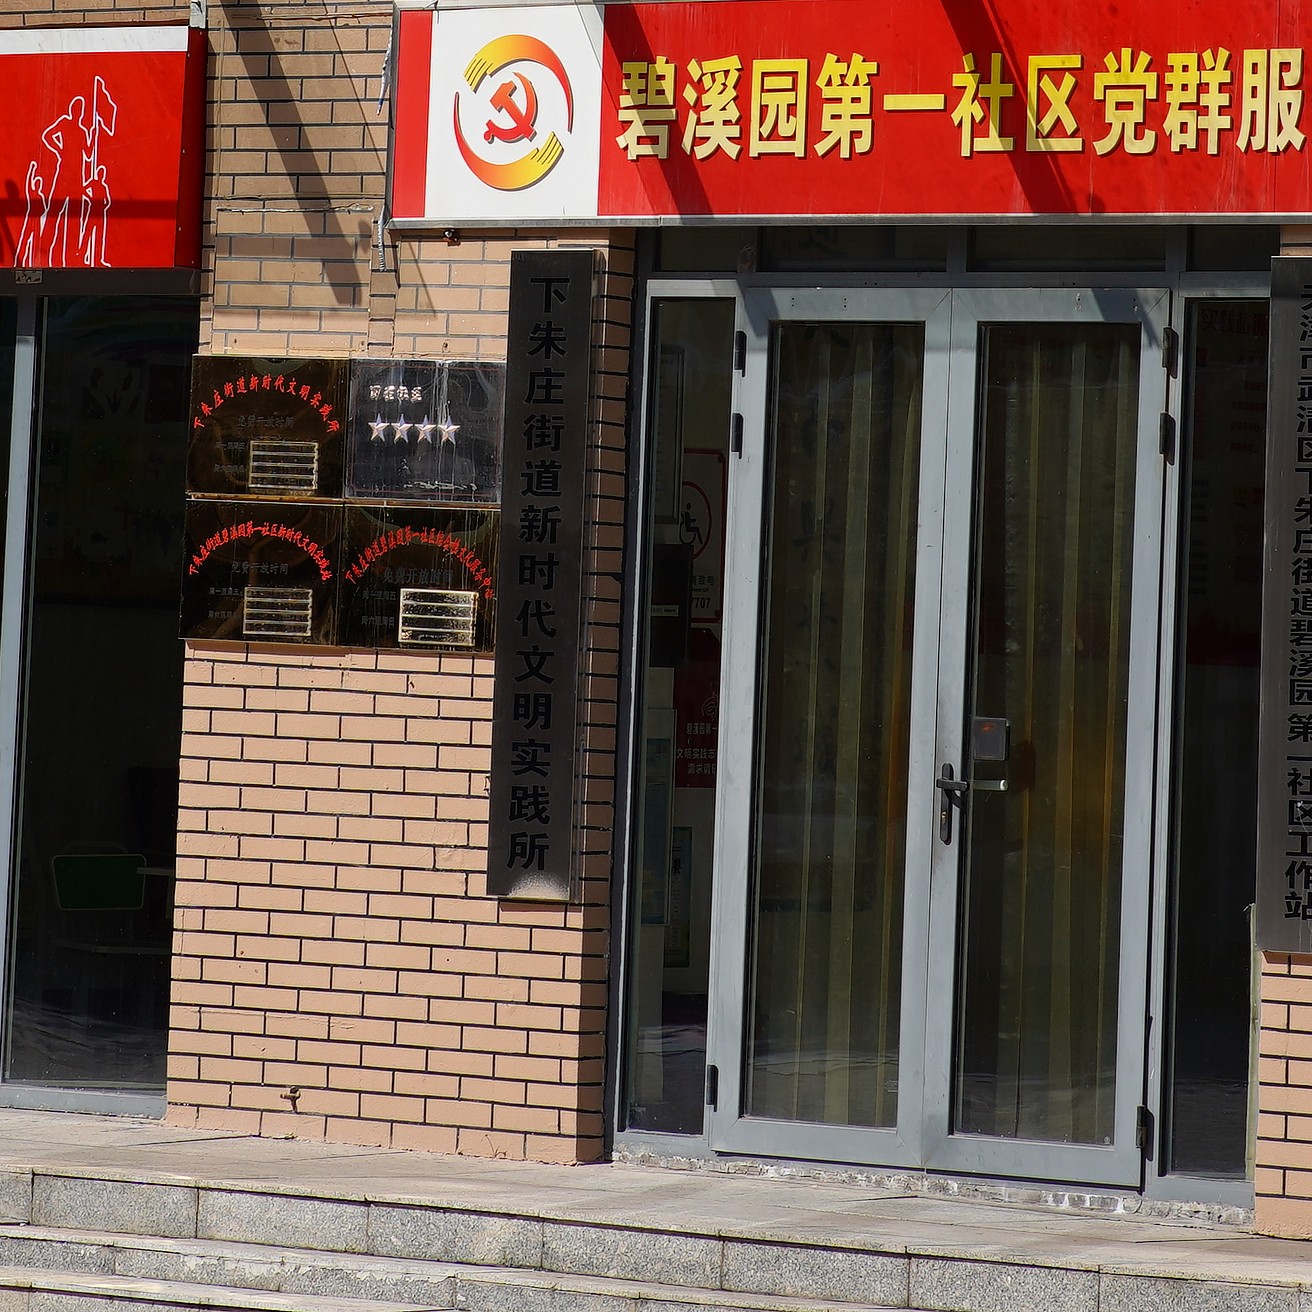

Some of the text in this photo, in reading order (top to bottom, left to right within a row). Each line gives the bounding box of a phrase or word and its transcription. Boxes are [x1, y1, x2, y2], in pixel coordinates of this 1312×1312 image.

[506, 276, 571, 872] 下朱庄街道新时代文明实践所
